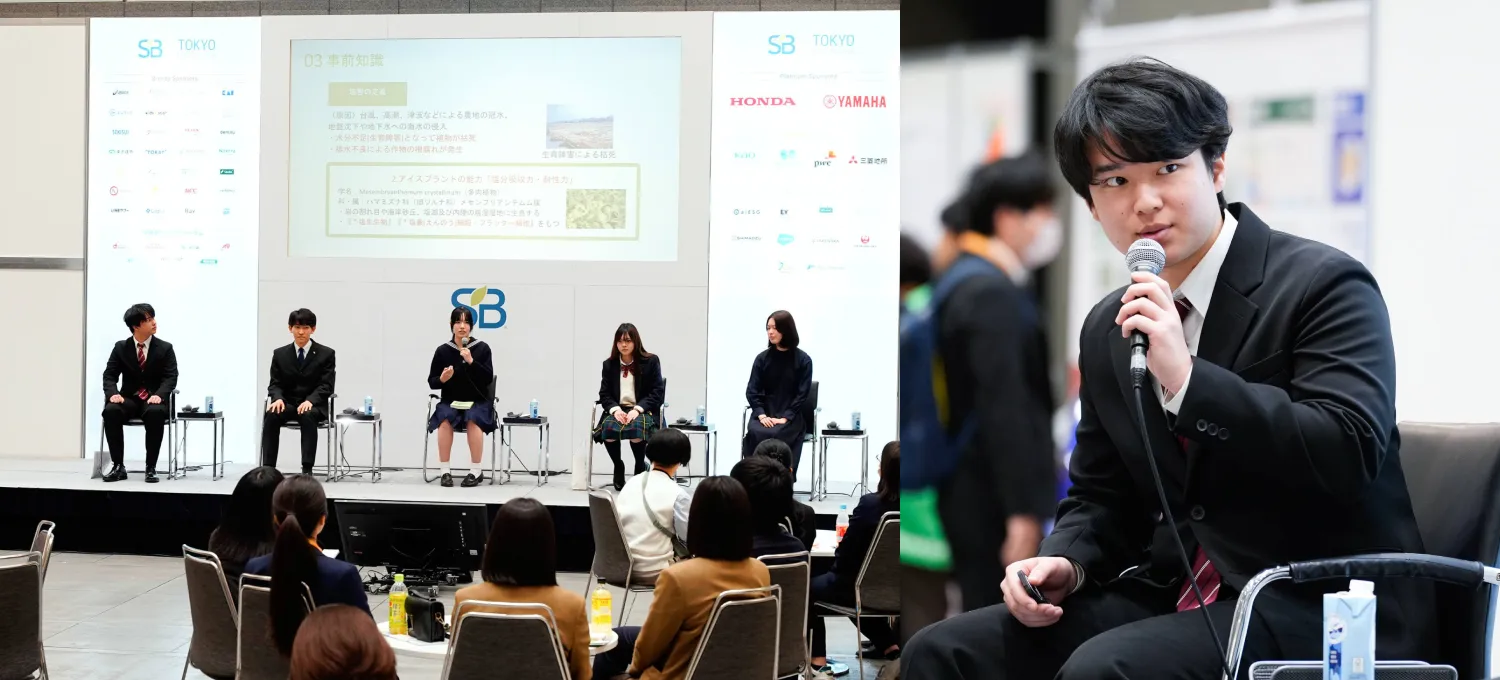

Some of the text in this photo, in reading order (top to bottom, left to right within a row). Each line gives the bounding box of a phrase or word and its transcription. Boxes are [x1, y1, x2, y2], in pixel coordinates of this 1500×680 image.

[178, 39, 216, 50] TOKYO
[768, 34, 796, 55] SB
[813, 34, 855, 47] TOKYO
[138, 39, 163, 58] SB
[304, 54, 384, 67] 03 事前知識
[730, 97, 796, 106] HONDA
[838, 95, 887, 108] YAMAHA
